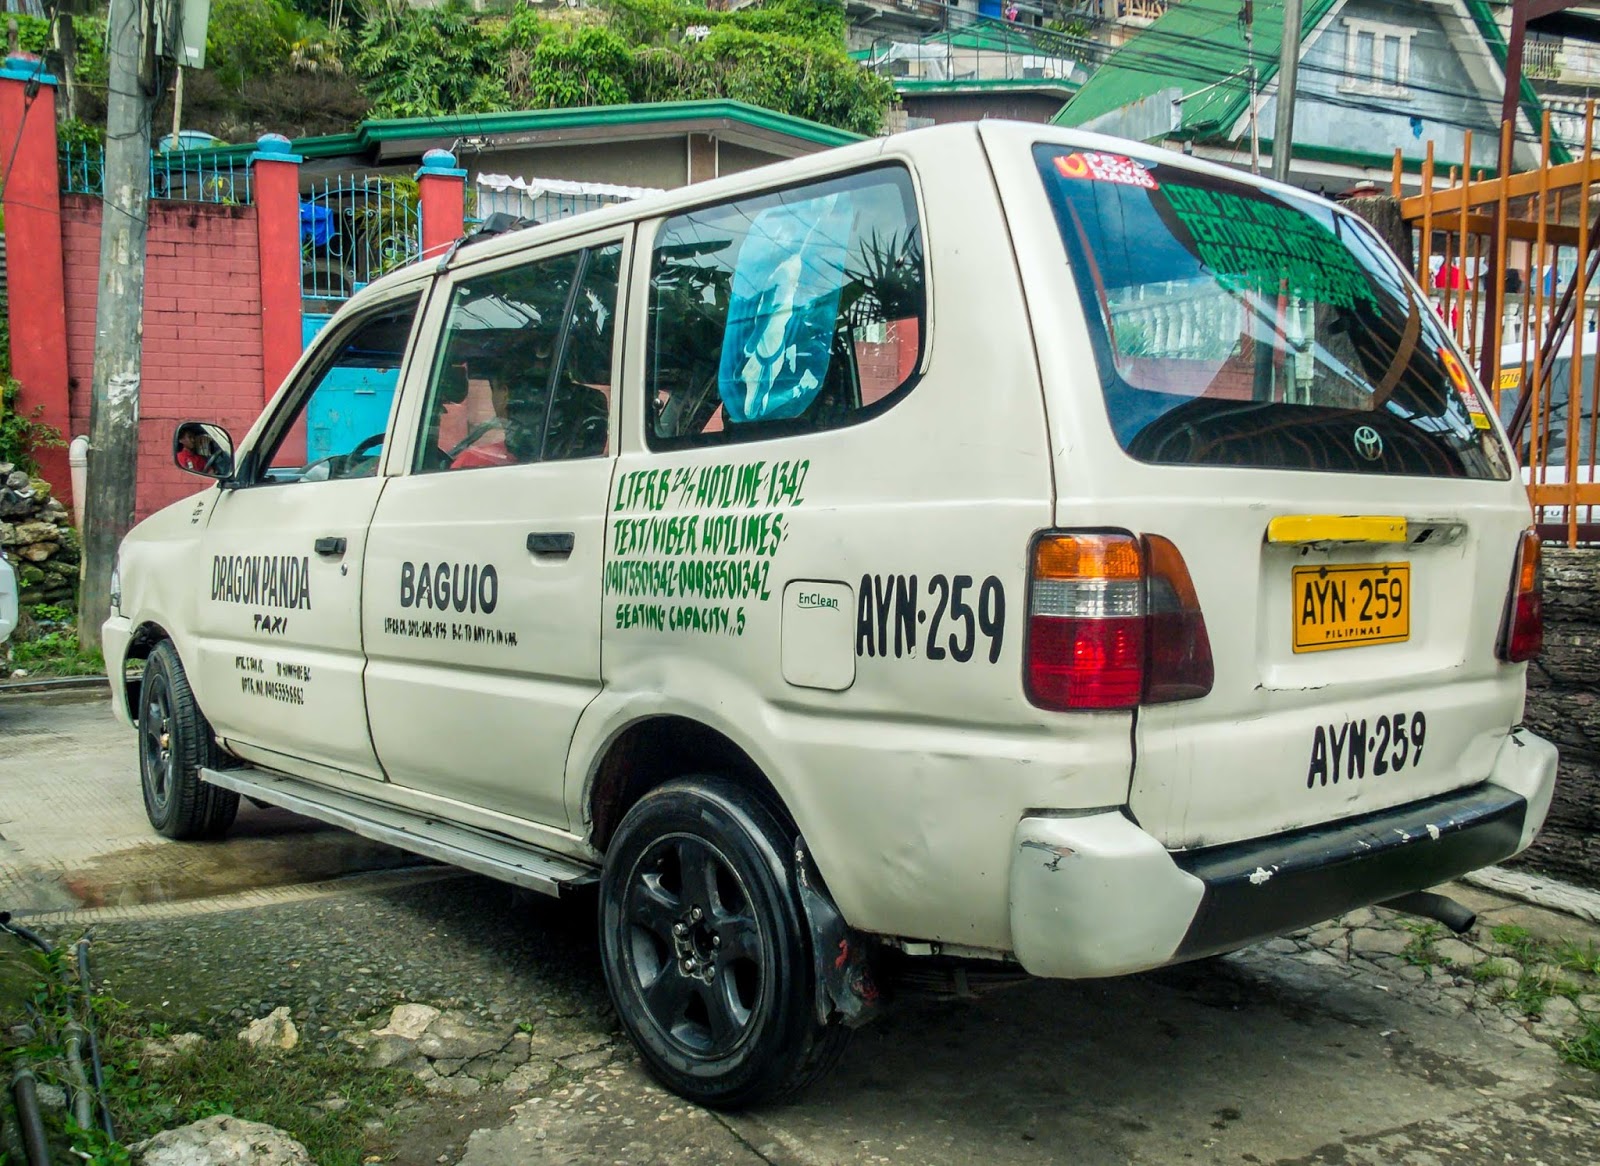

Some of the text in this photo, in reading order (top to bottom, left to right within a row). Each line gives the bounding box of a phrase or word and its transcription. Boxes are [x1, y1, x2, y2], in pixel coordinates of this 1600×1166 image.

[1092, 168, 1155, 188] RADIO
[614, 468, 673, 512] LTFRB
[211, 555, 312, 611] DRAGON PANDA
[400, 561, 499, 614] BAGUIO
[798, 592, 839, 608] EnClean
[253, 613, 288, 635] TAXI
[615, 603, 667, 633] SEATING
[1325, 625, 1382, 639] PILIPINAS
